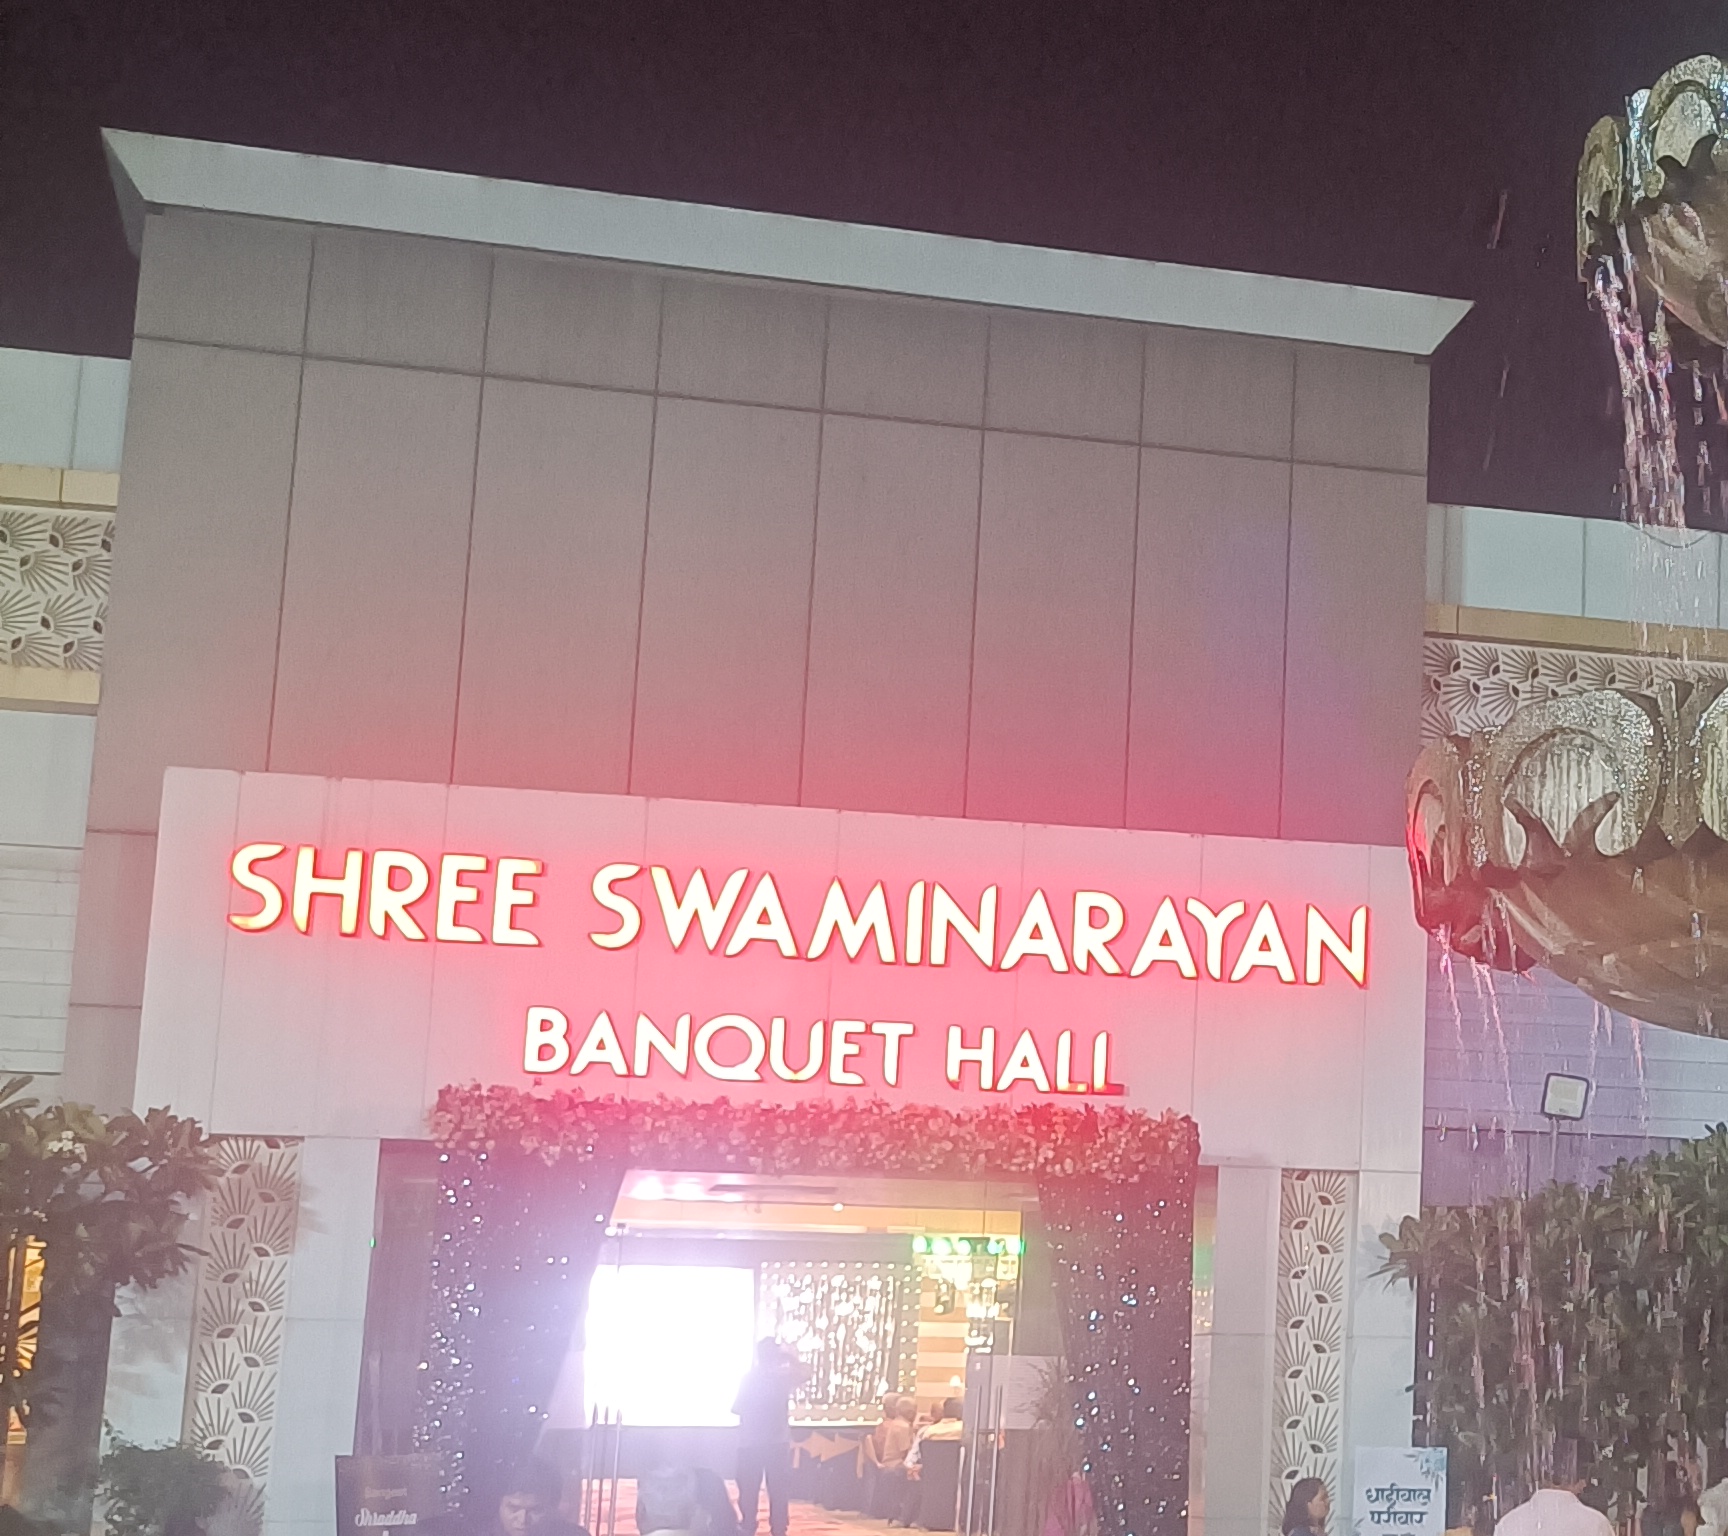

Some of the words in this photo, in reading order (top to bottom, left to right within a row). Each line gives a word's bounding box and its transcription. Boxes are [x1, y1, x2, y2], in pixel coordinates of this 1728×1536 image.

[227, 842, 543, 948] SHREE
[588, 862, 1371, 990] SWAMINARAYAN
[522, 1004, 915, 1088] BANQUET
[945, 1024, 1127, 1095] HALL
